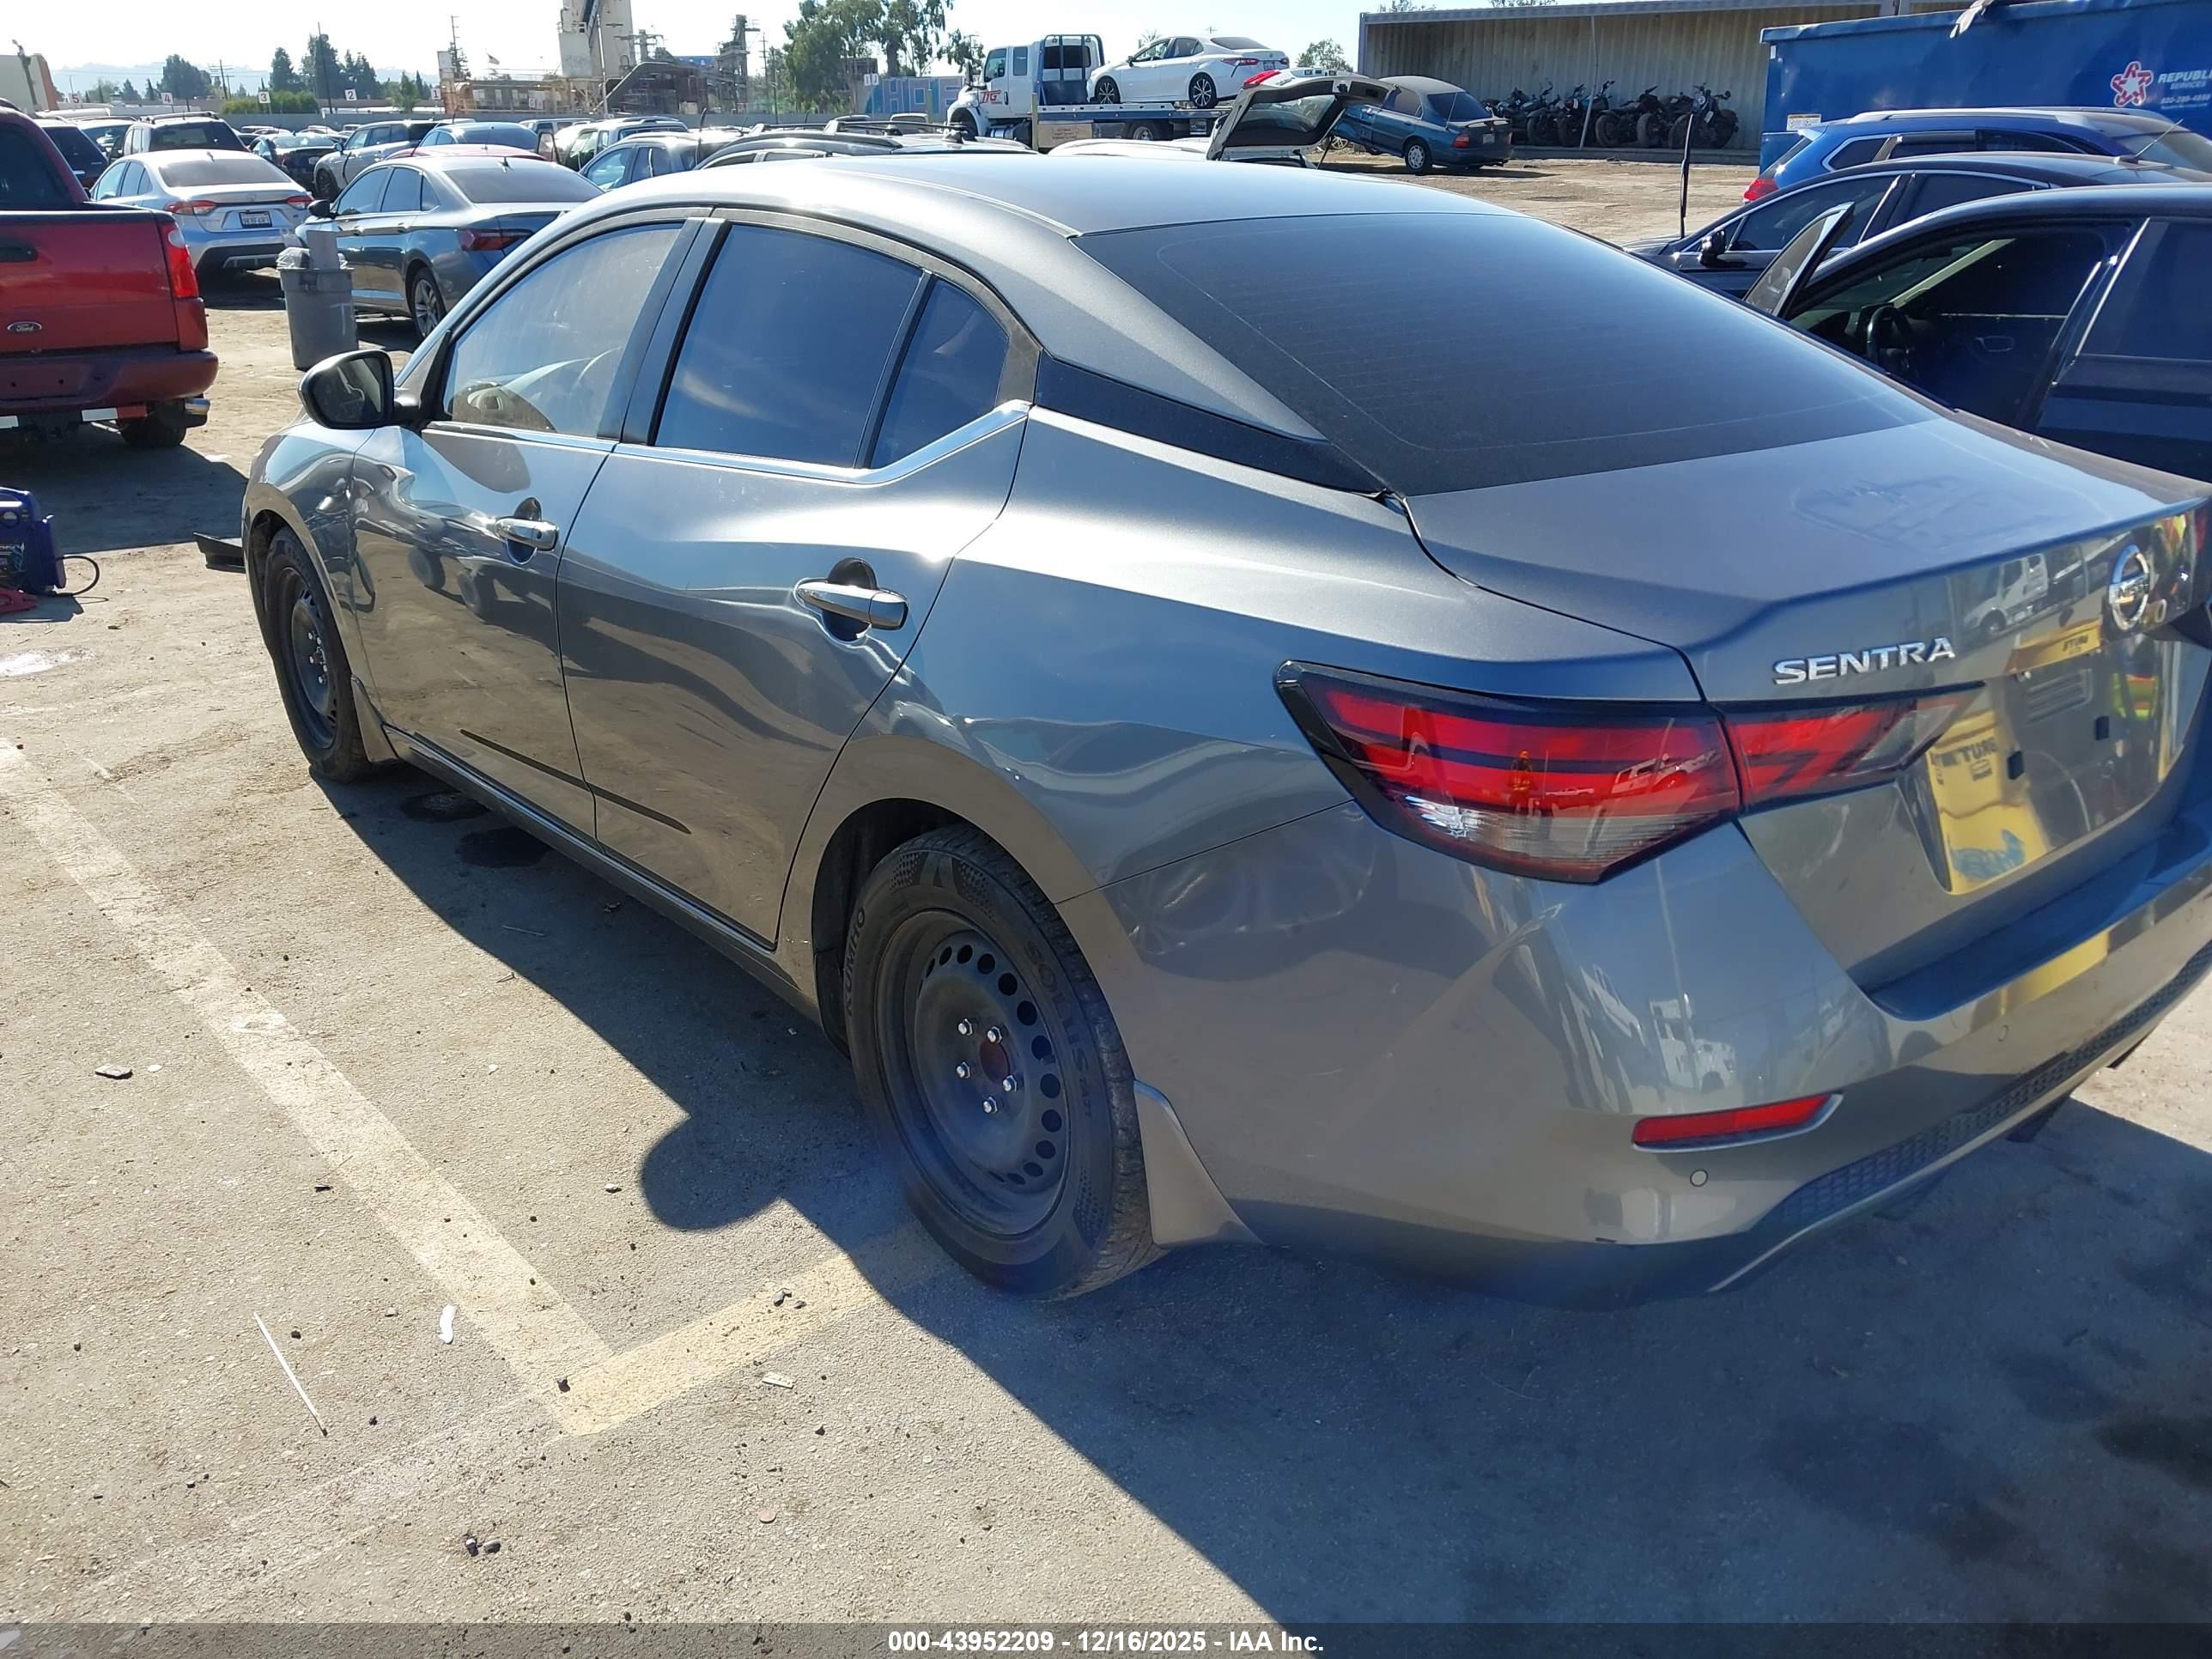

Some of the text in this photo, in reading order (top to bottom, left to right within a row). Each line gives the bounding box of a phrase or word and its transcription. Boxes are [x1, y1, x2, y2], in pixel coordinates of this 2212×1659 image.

[1773, 636, 1956, 684] SENTRA
[845, 906, 866, 1017] KUMHO
[1024, 941, 1089, 1072] SOLUS
